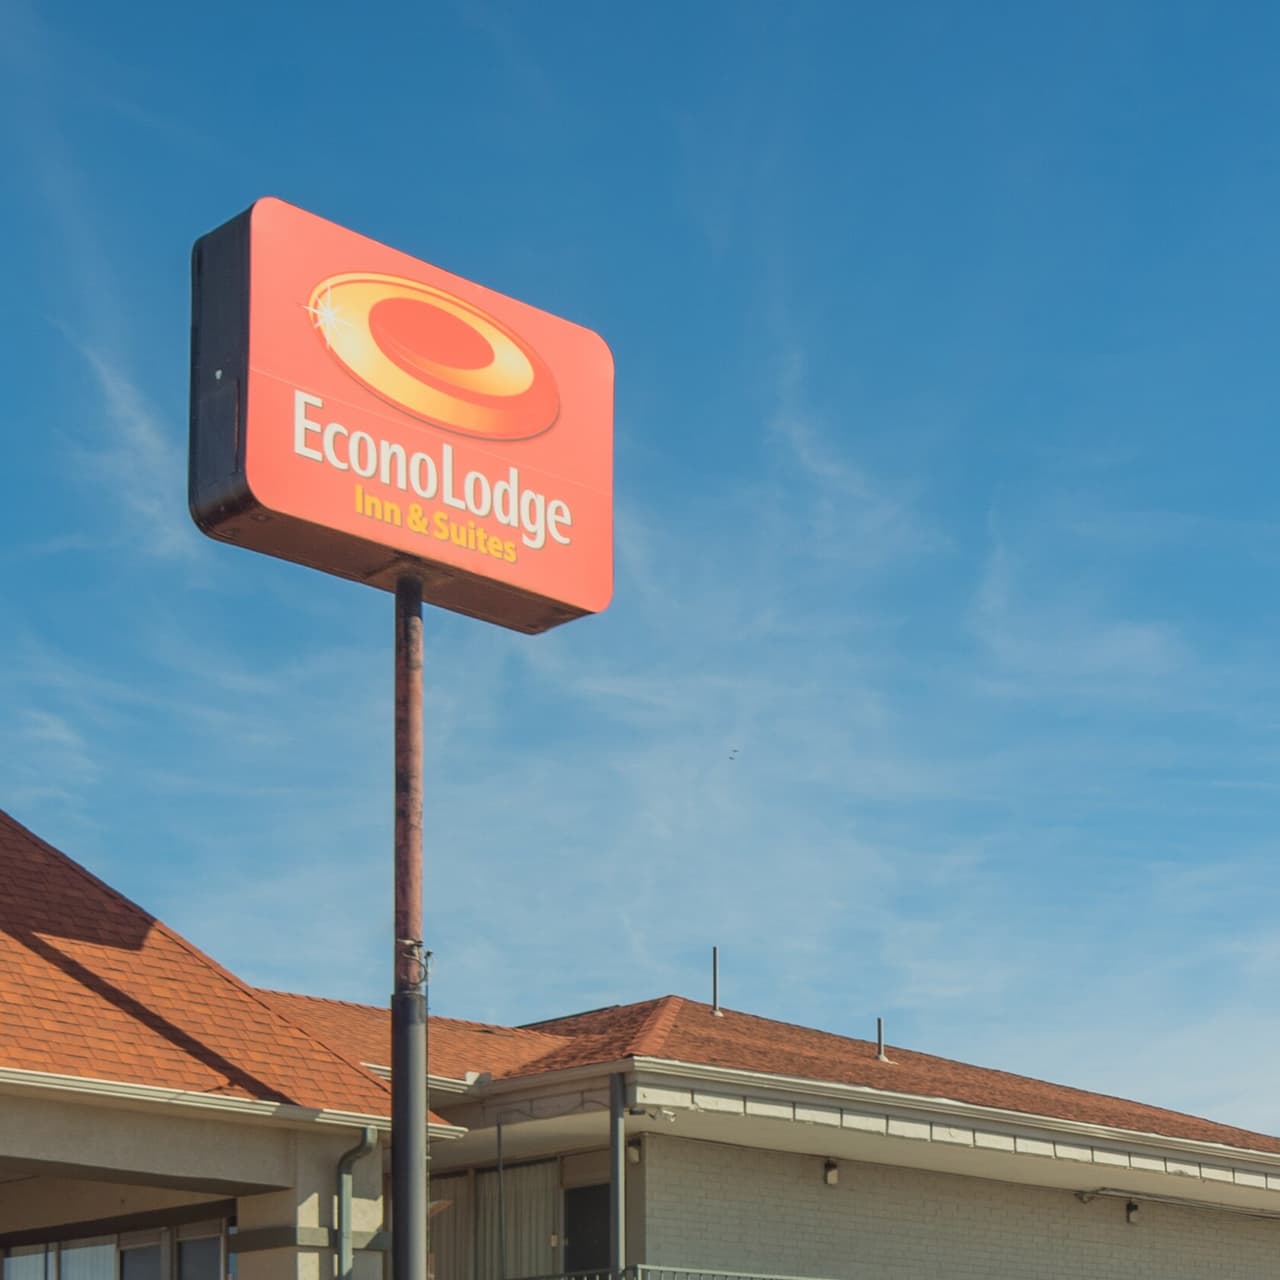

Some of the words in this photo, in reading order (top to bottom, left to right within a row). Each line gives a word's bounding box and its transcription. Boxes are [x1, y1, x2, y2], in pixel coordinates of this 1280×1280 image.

[294, 390, 572, 549] EconoLodge
[354, 484, 402, 527] Inn
[406, 503, 430, 536] &
[433, 512, 517, 562] Suites
